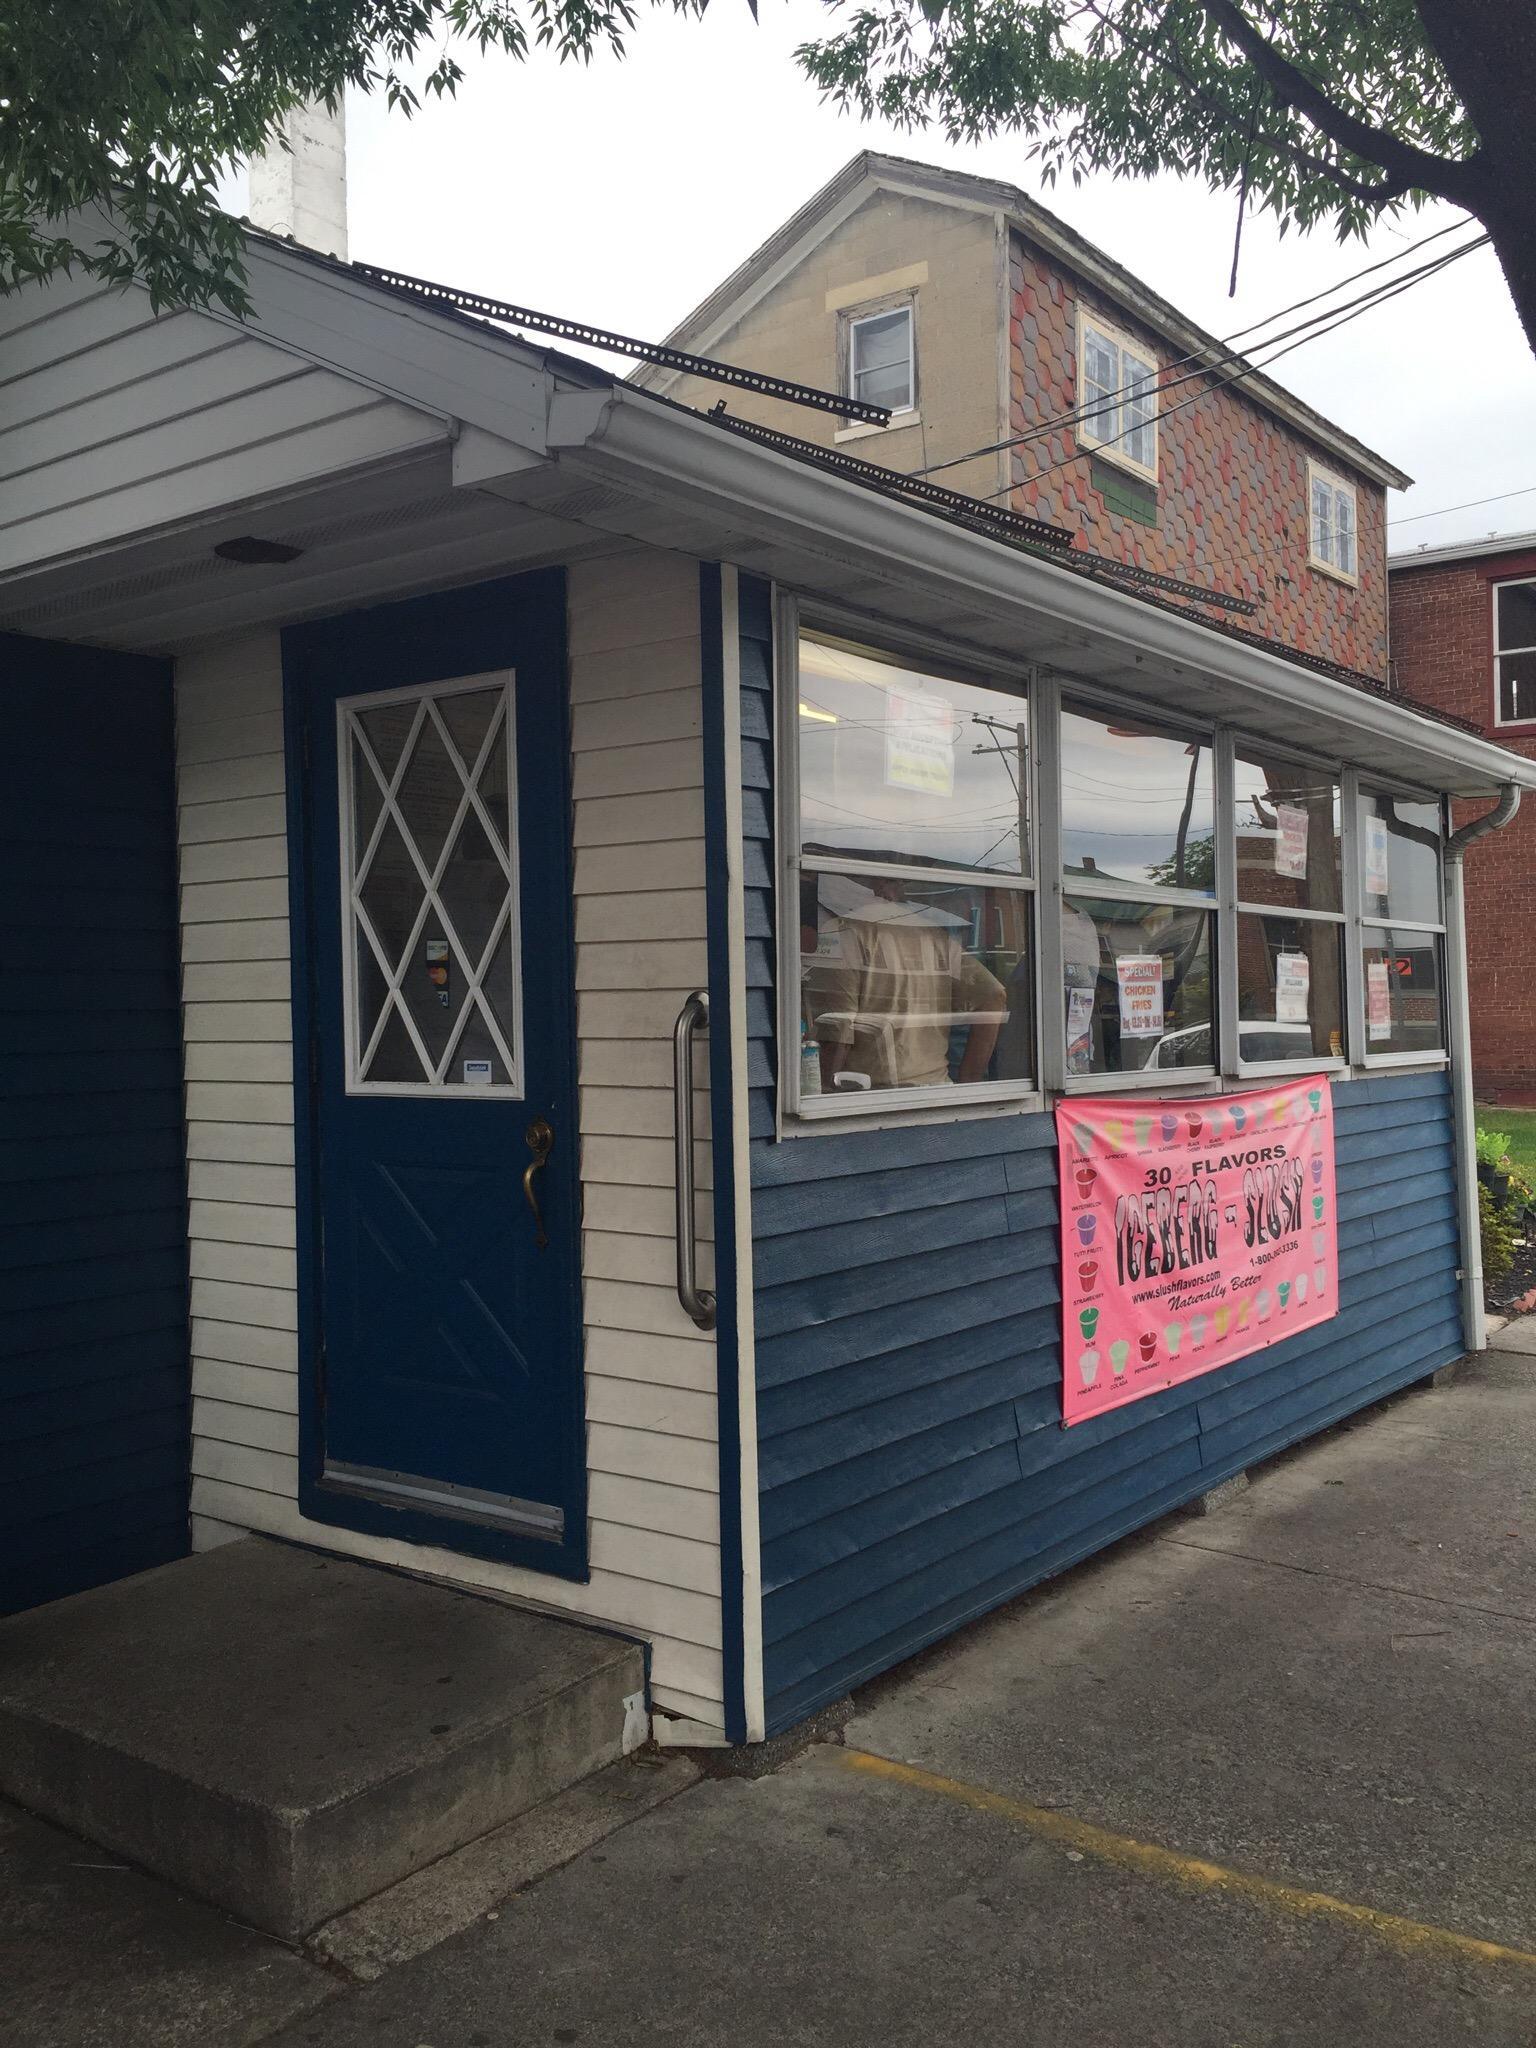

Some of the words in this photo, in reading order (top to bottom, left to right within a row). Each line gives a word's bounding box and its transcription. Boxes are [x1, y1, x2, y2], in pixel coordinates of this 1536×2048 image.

[1125, 985, 1156, 996] CHICKEN
[1104, 1153, 1128, 1161] APRICOT
[1144, 1166, 1172, 1188] 30
[1191, 1145, 1287, 1177] FLAVORS
[1114, 1178, 1219, 1286] ICEBERG
[1243, 1156, 1304, 1248] SLUSH
[1131, 1270, 1221, 1305] www.slushflavors.com
[1167, 1285, 1227, 1312] Naturally
[1230, 1274, 1262, 1291] Better
[1077, 1384, 1102, 1396] PINEAPPLE
